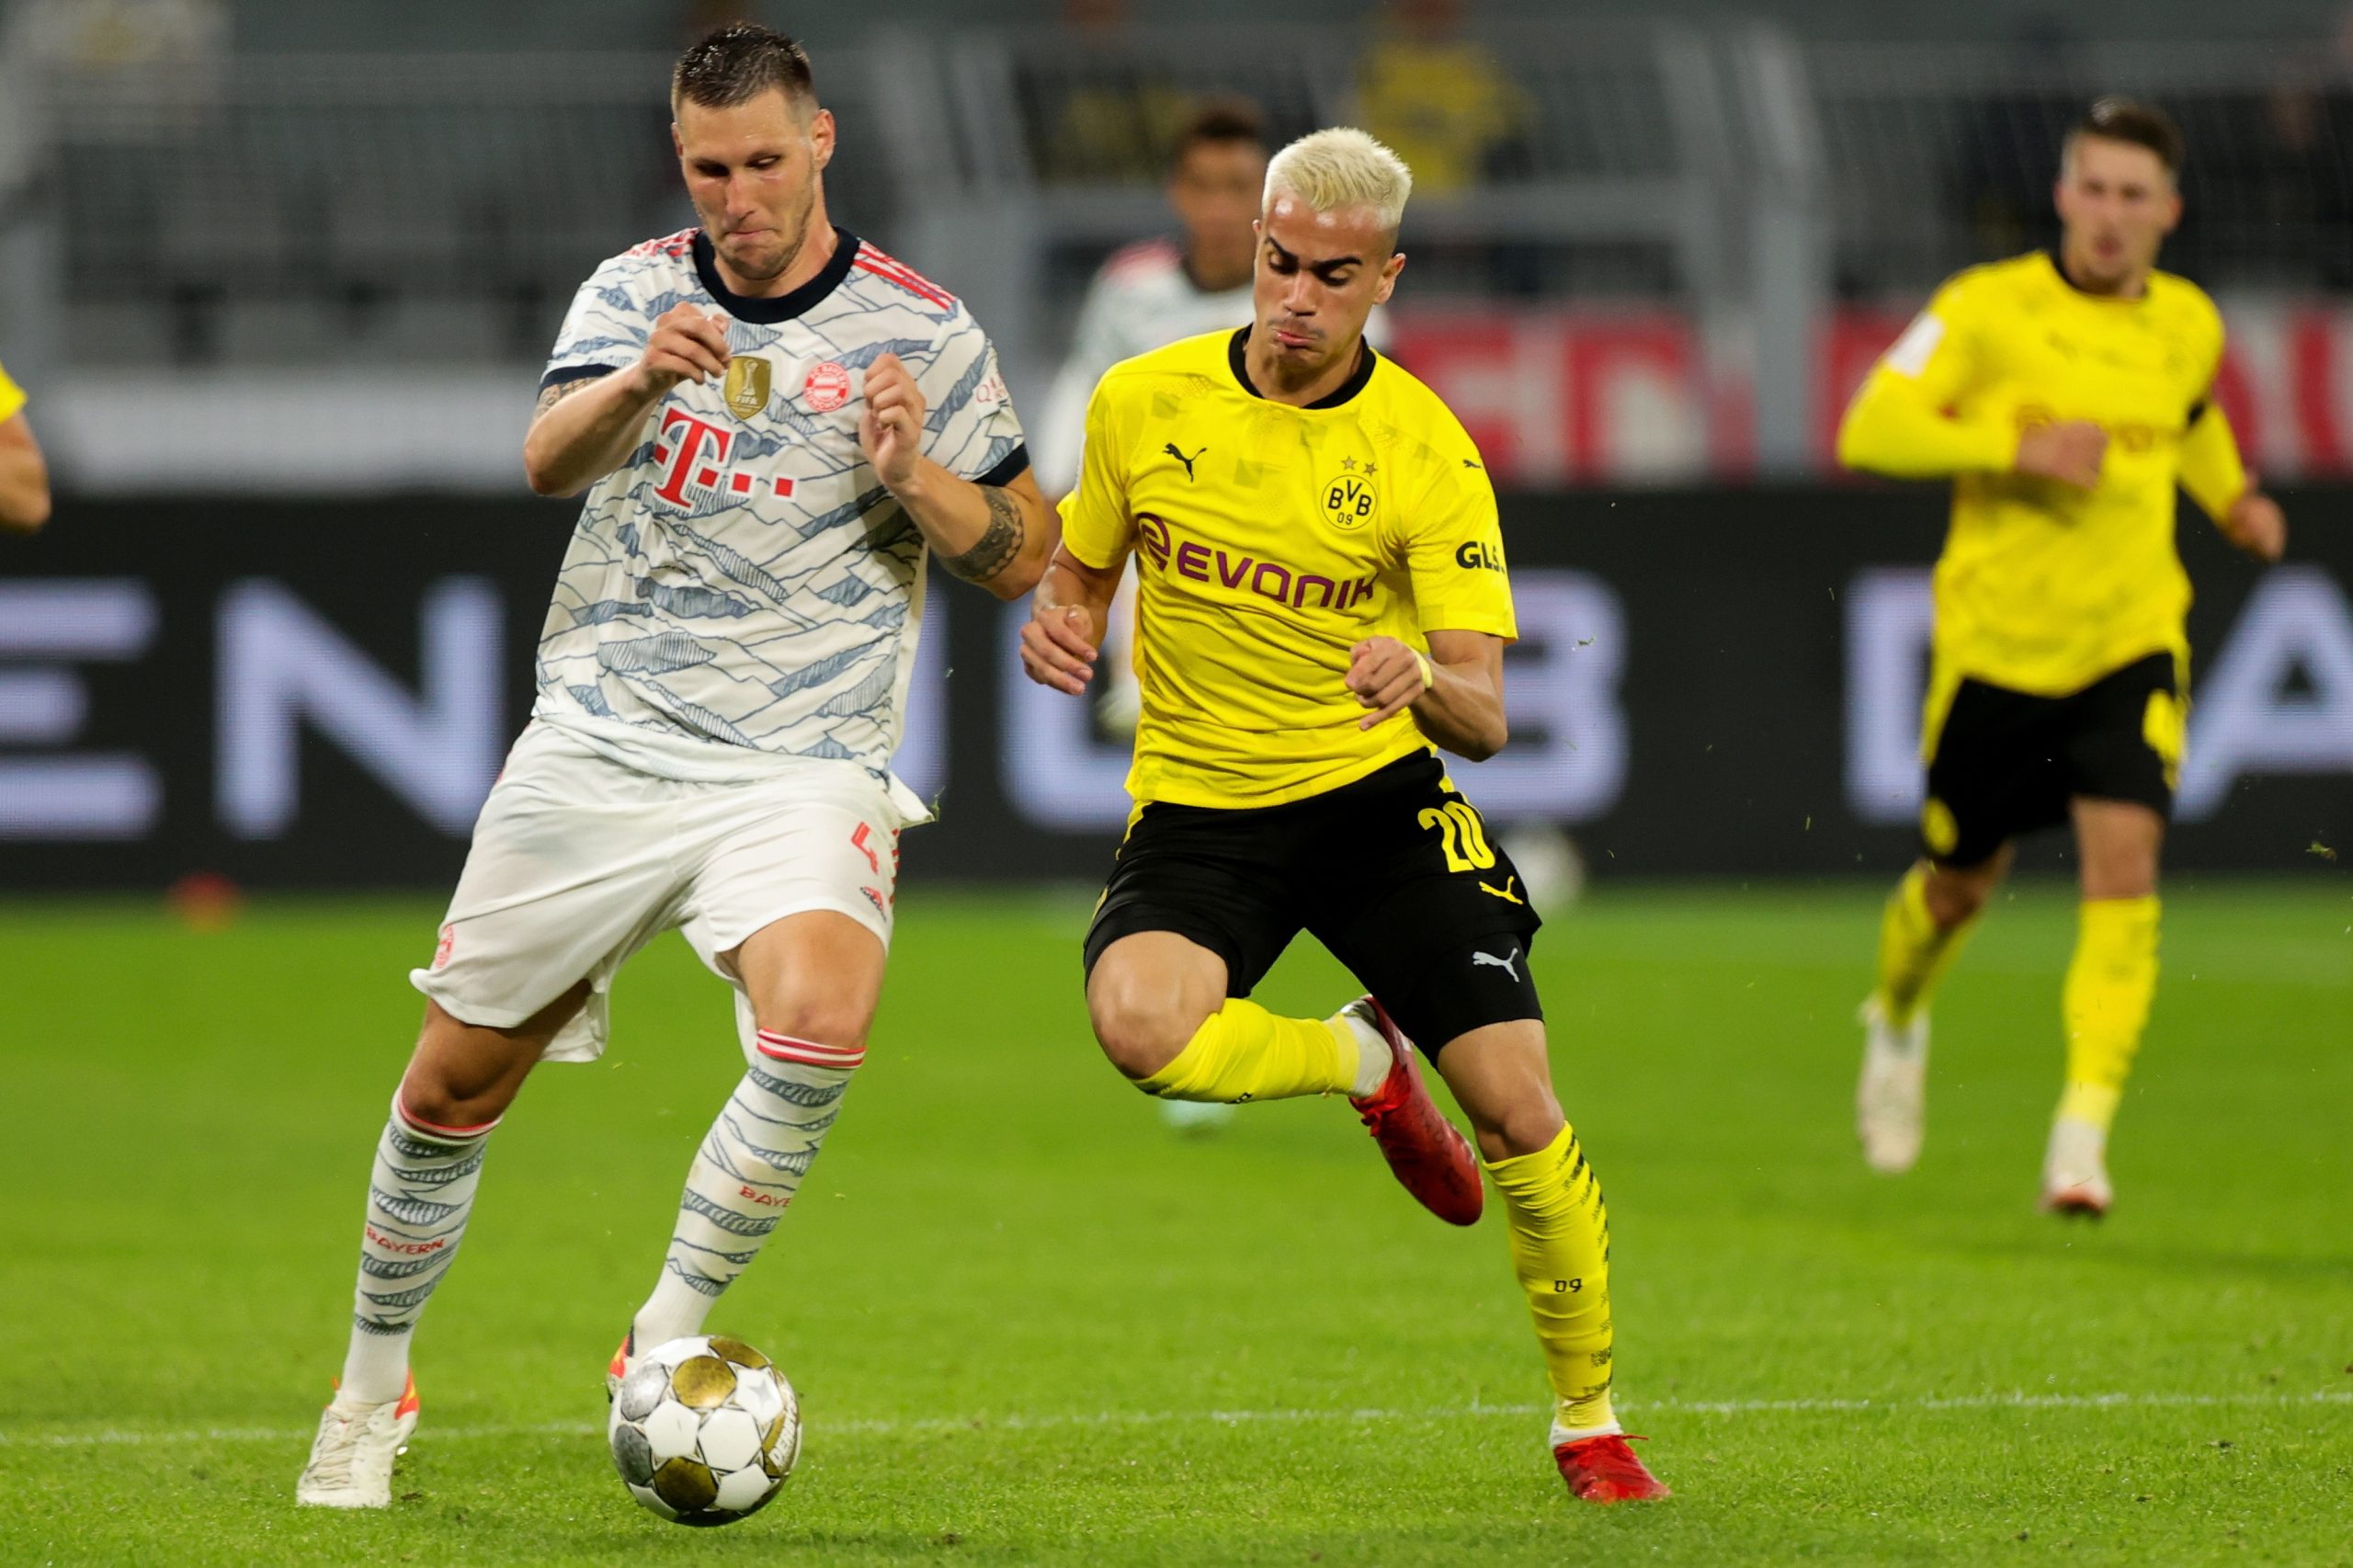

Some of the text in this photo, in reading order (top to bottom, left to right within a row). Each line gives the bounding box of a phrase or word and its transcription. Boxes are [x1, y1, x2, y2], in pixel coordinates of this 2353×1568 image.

[735, 395, 758, 405] FIFA
[1327, 479, 1372, 517] BVB
[1337, 511, 1354, 525] 09
[1417, 801, 1495, 873] 20
[366, 1224, 446, 1255] BAYERN
[1554, 1278, 1582, 1293] 09
